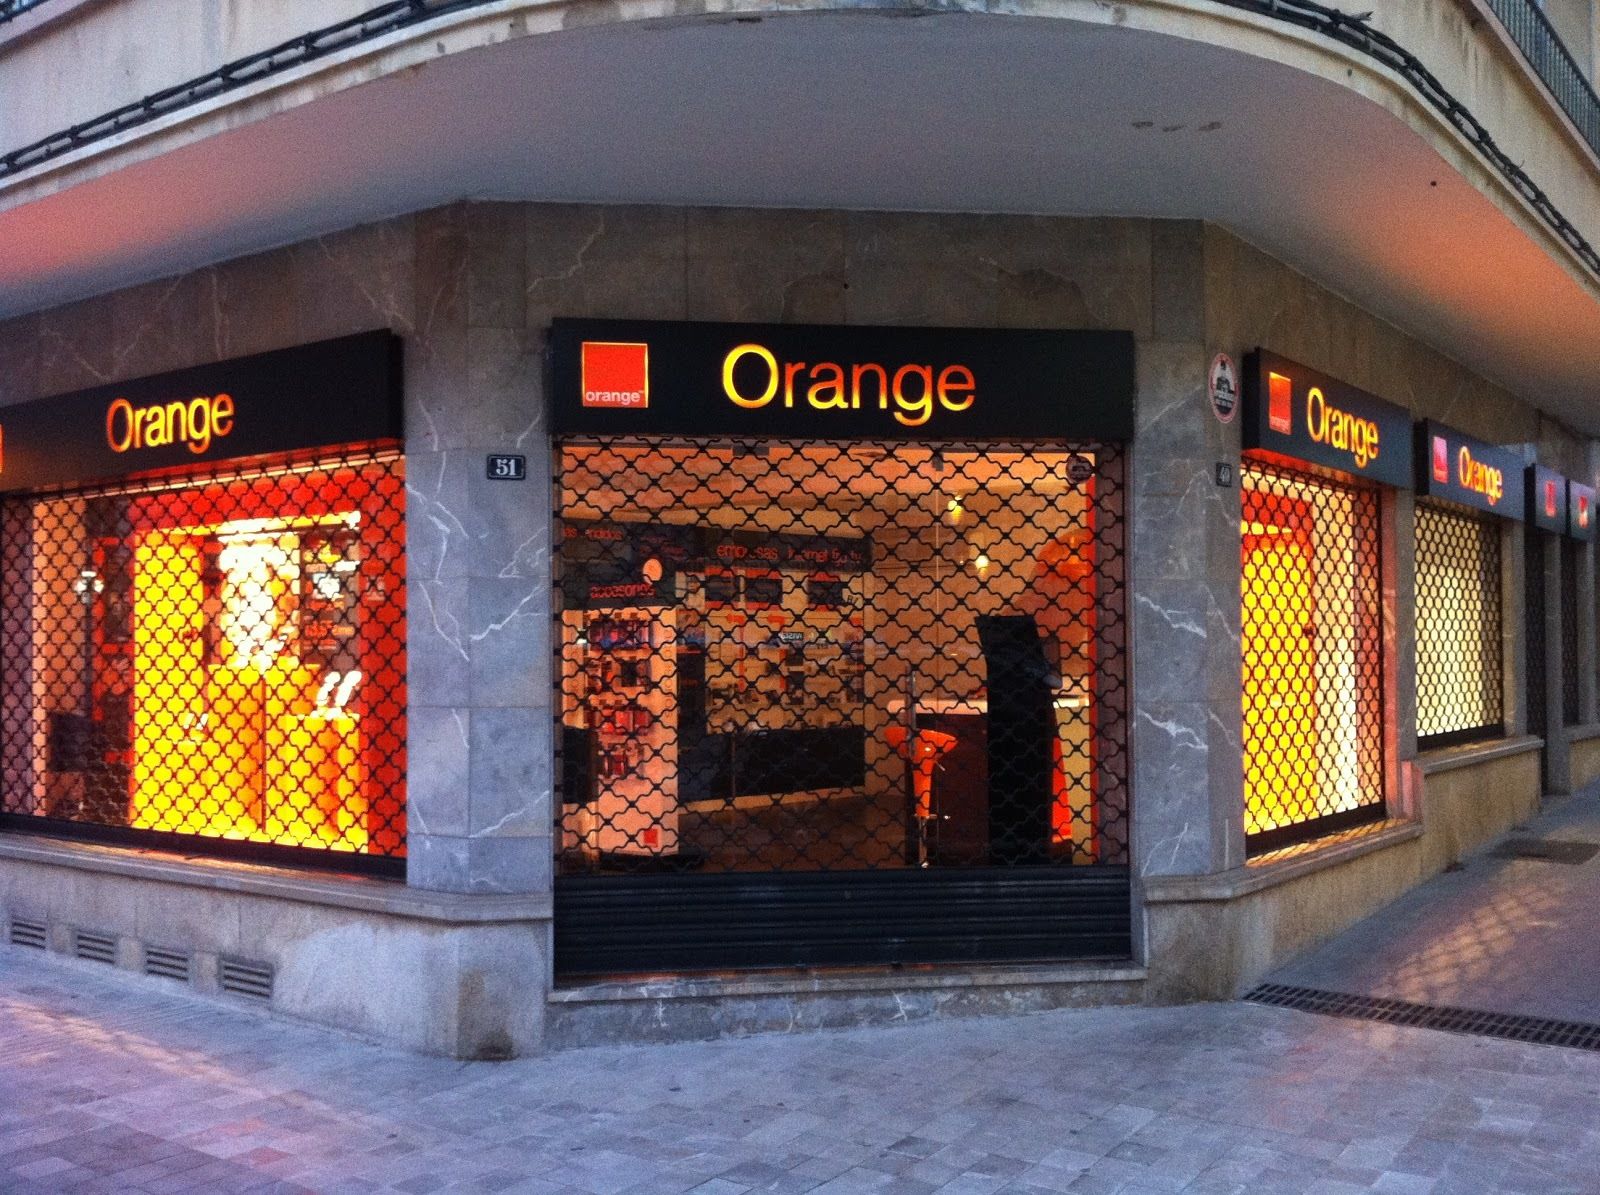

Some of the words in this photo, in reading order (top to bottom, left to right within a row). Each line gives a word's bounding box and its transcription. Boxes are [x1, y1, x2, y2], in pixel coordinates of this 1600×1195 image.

[722, 343, 977, 426] Orange
[106, 392, 235, 454] Orange
[1307, 387, 1379, 468] Orange
[496, 459, 516, 476] 51
[1458, 445, 1503, 506] Orange
